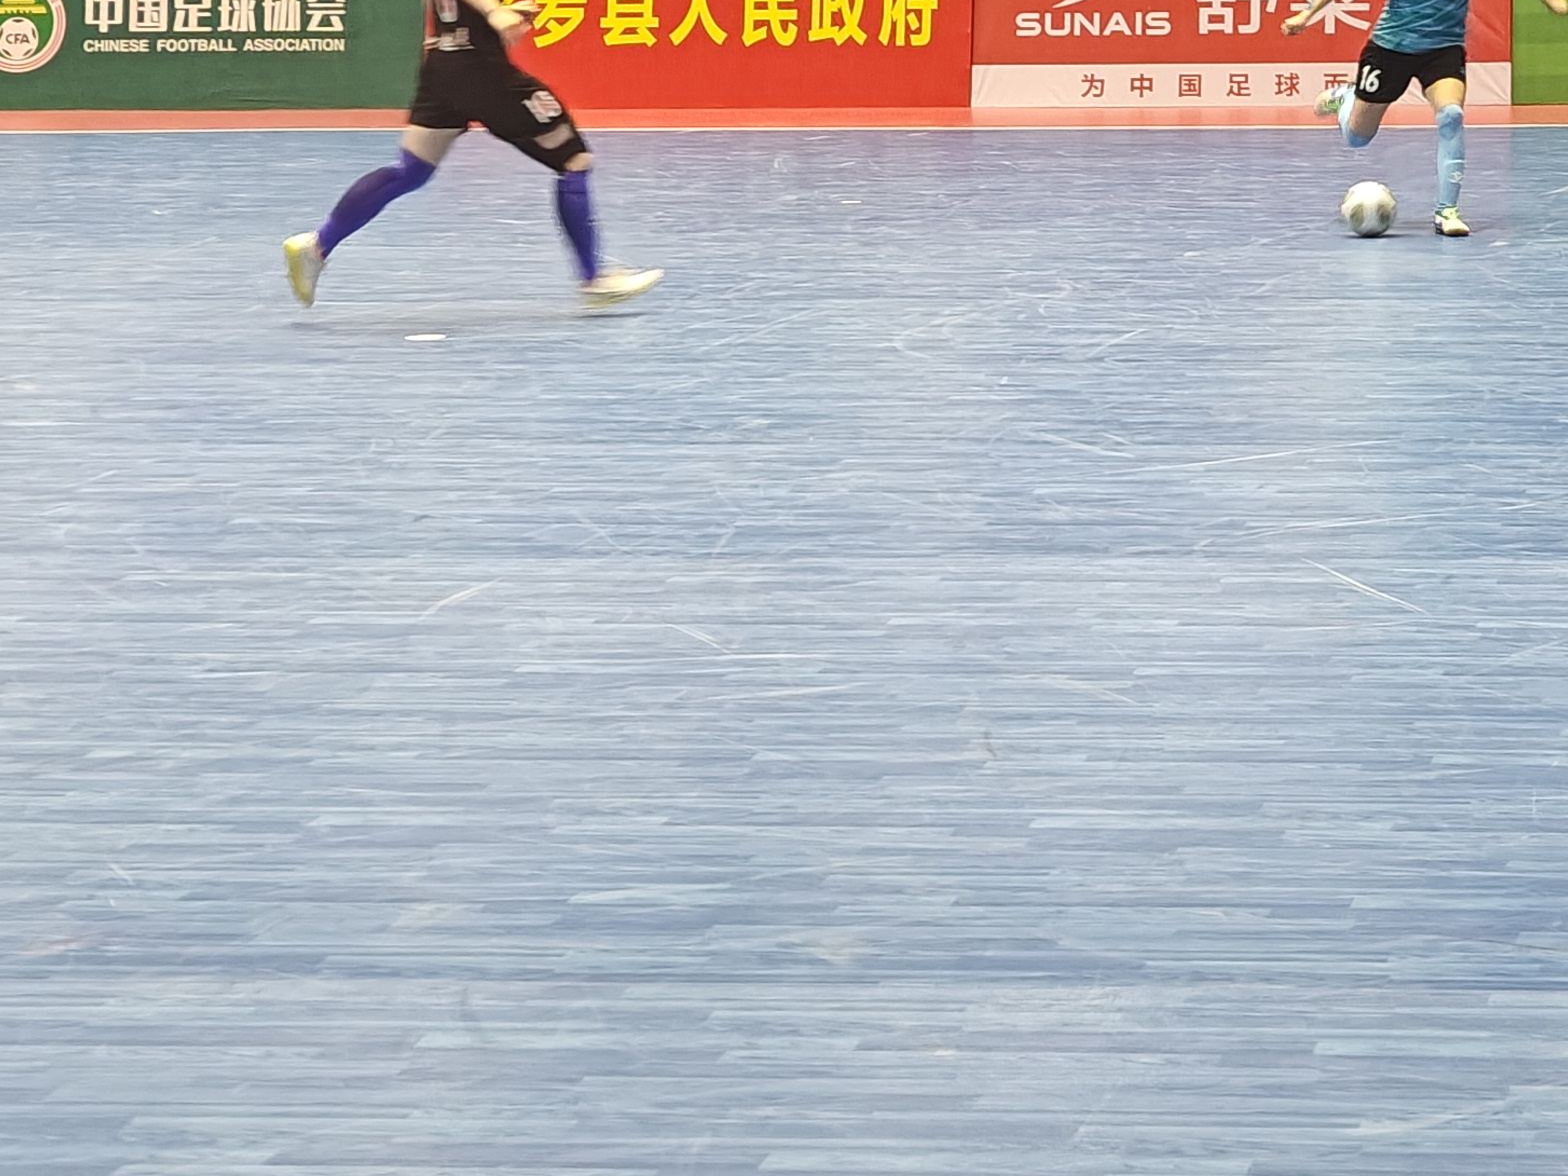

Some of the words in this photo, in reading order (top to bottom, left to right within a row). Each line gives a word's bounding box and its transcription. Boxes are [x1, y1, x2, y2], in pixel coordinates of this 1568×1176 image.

[1014, 11, 1172, 38] SUNAIS
[5, 33, 31, 45] CFA
[83, 38, 150, 53] CHINESE
[156, 38, 237, 53] FOOTBALL
[243, 37, 346, 53] ASSOCIATION
[1358, 64, 1383, 94] 16
